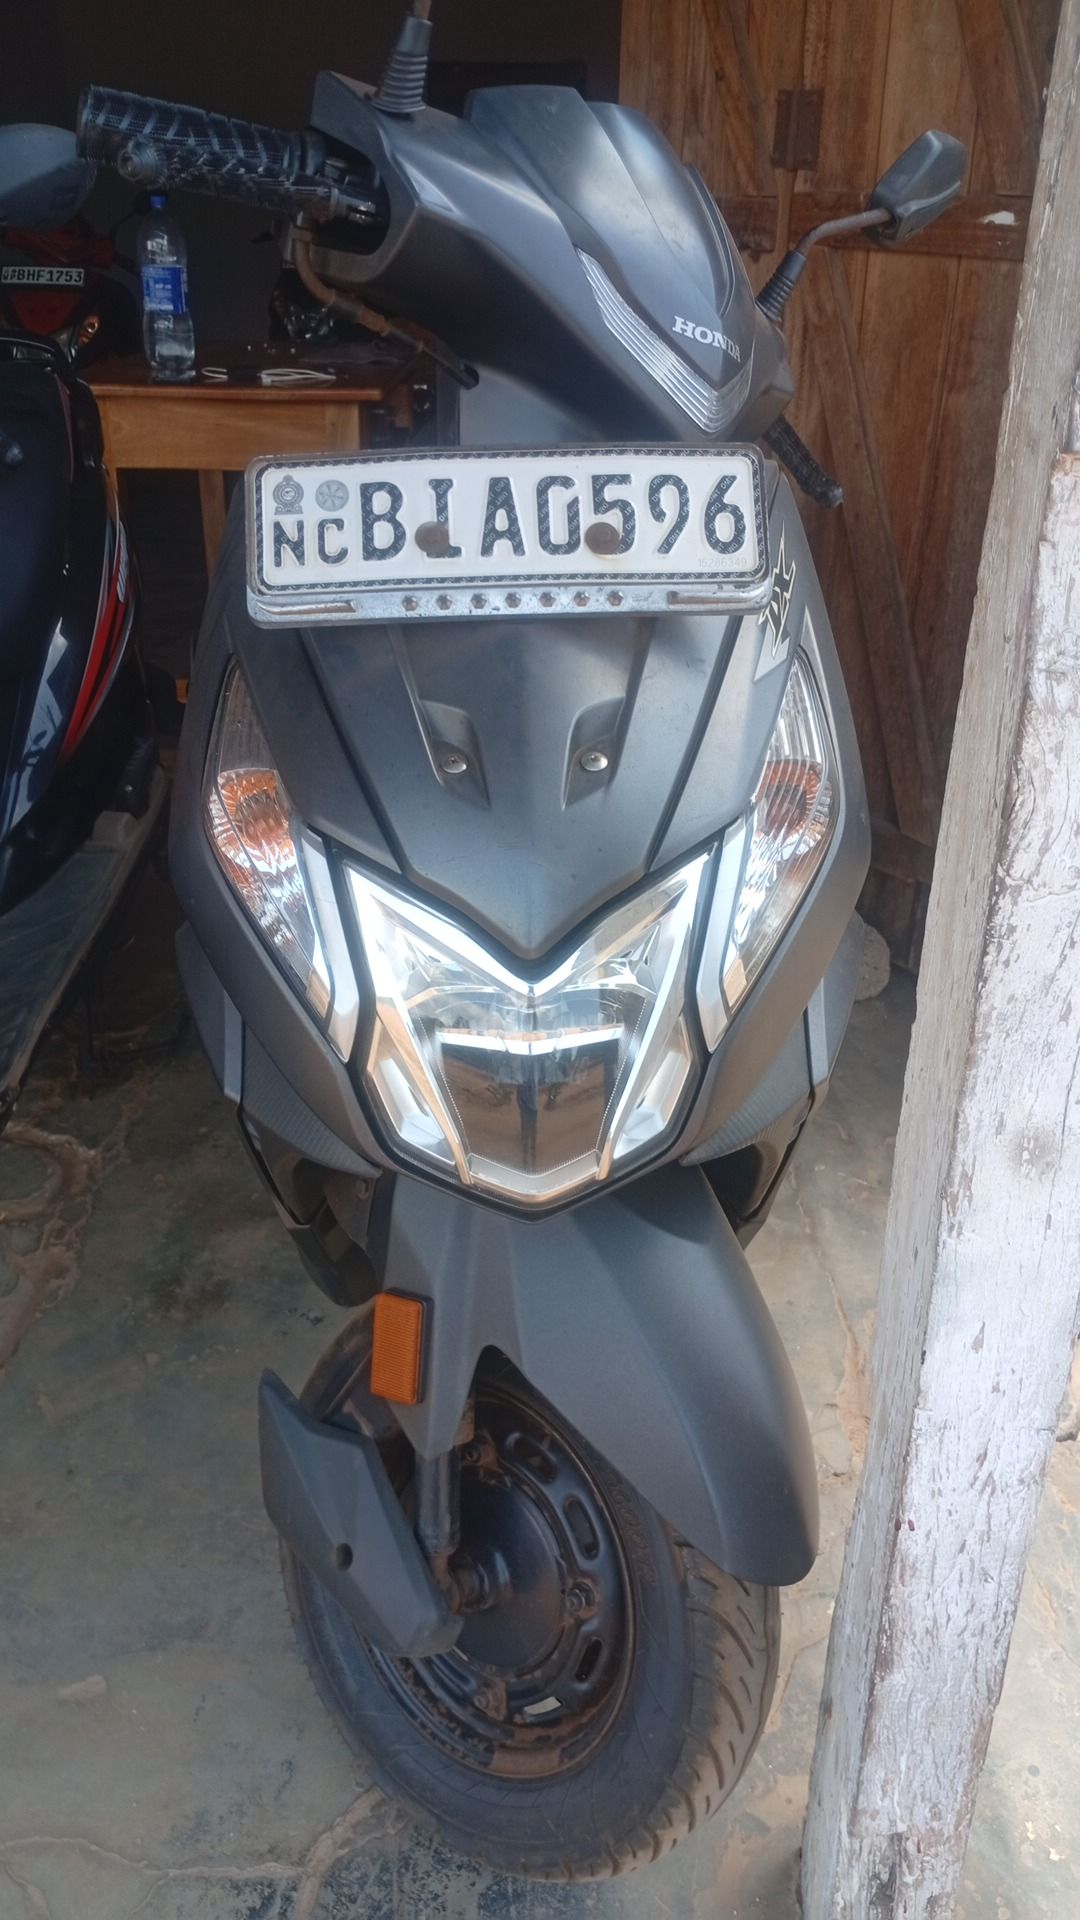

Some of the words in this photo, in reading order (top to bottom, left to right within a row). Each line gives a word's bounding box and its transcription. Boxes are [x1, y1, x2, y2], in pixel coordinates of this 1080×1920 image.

[17, 268, 83, 283] BHF1753
[672, 315, 741, 363] HONDA
[273, 517, 349, 567] NC
